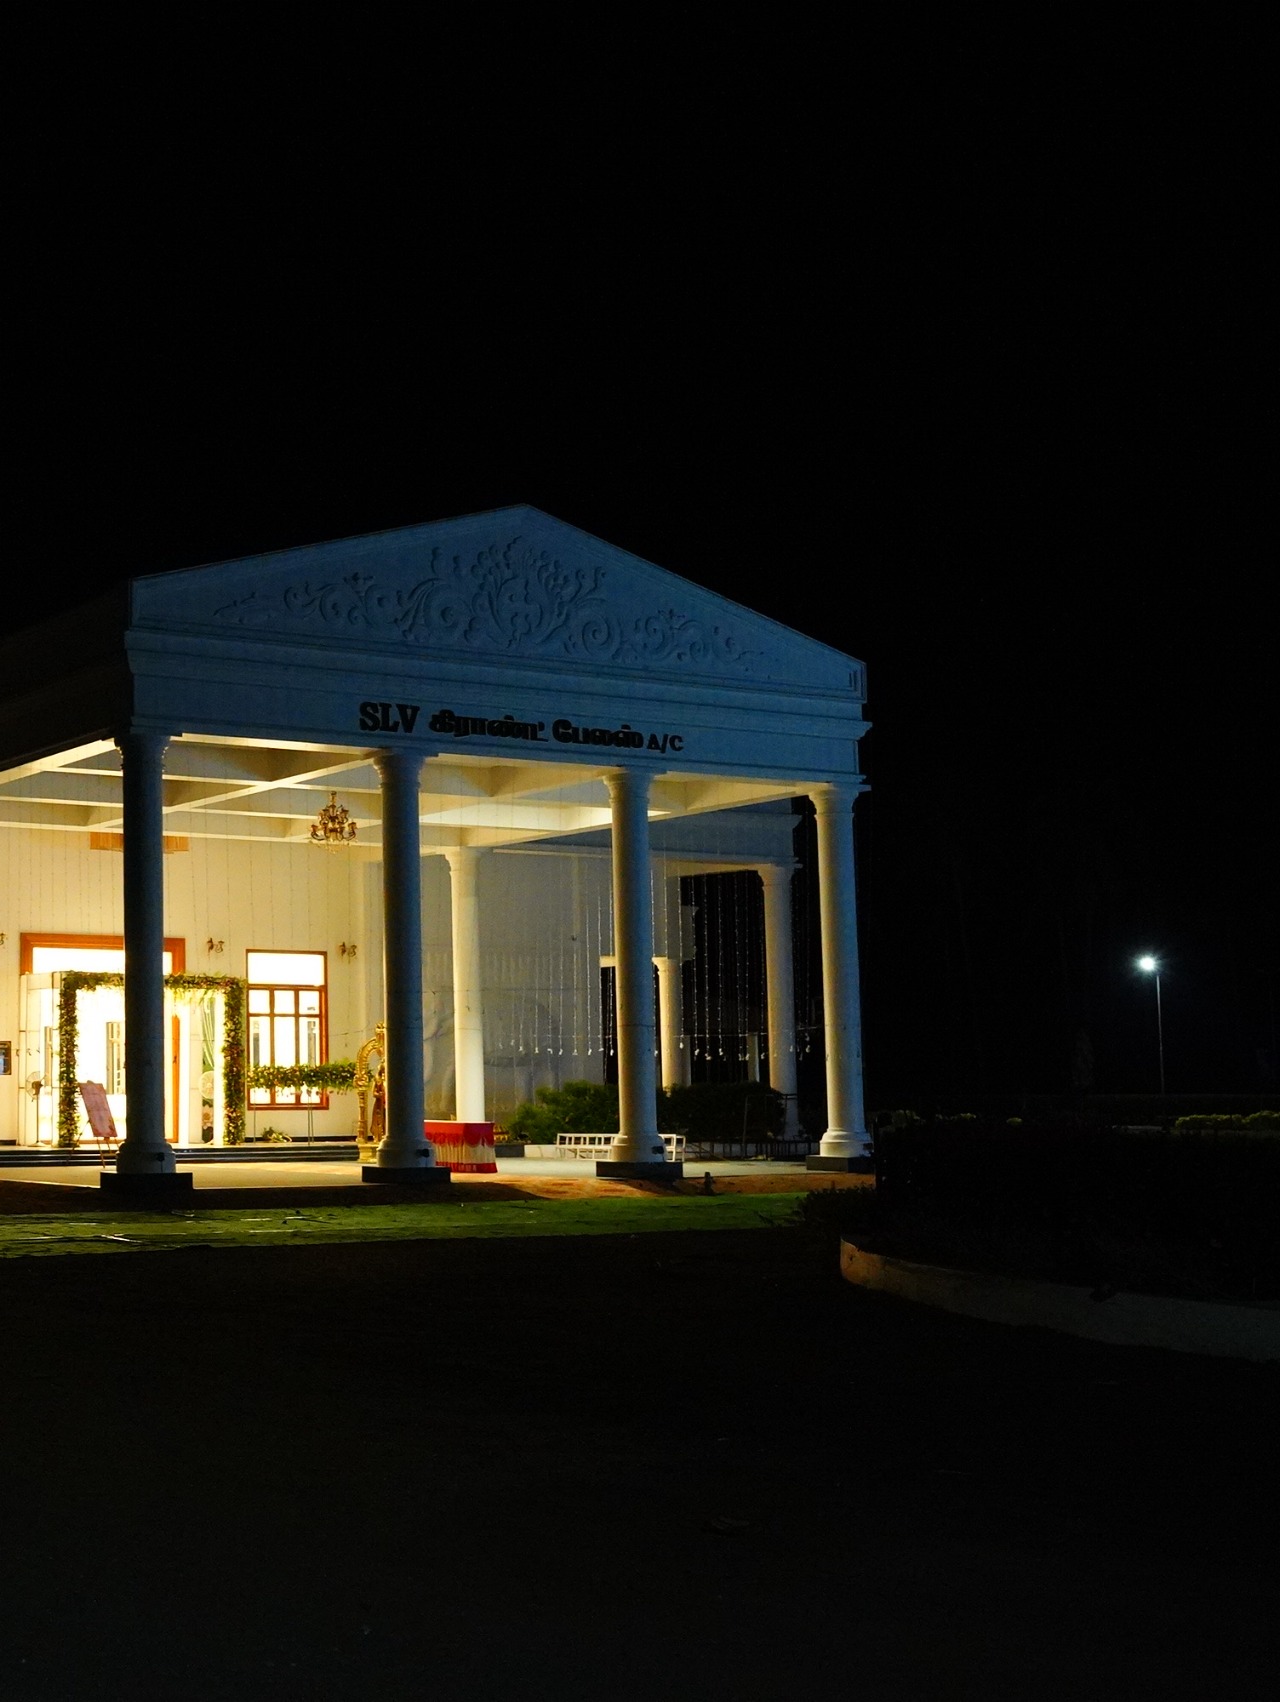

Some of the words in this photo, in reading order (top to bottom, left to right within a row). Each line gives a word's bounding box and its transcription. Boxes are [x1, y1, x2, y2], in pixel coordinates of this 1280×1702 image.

[359, 701, 420, 733] SLV
[429, 709, 549, 742] கிராண்ட்
[646, 733, 684, 753] A/C
